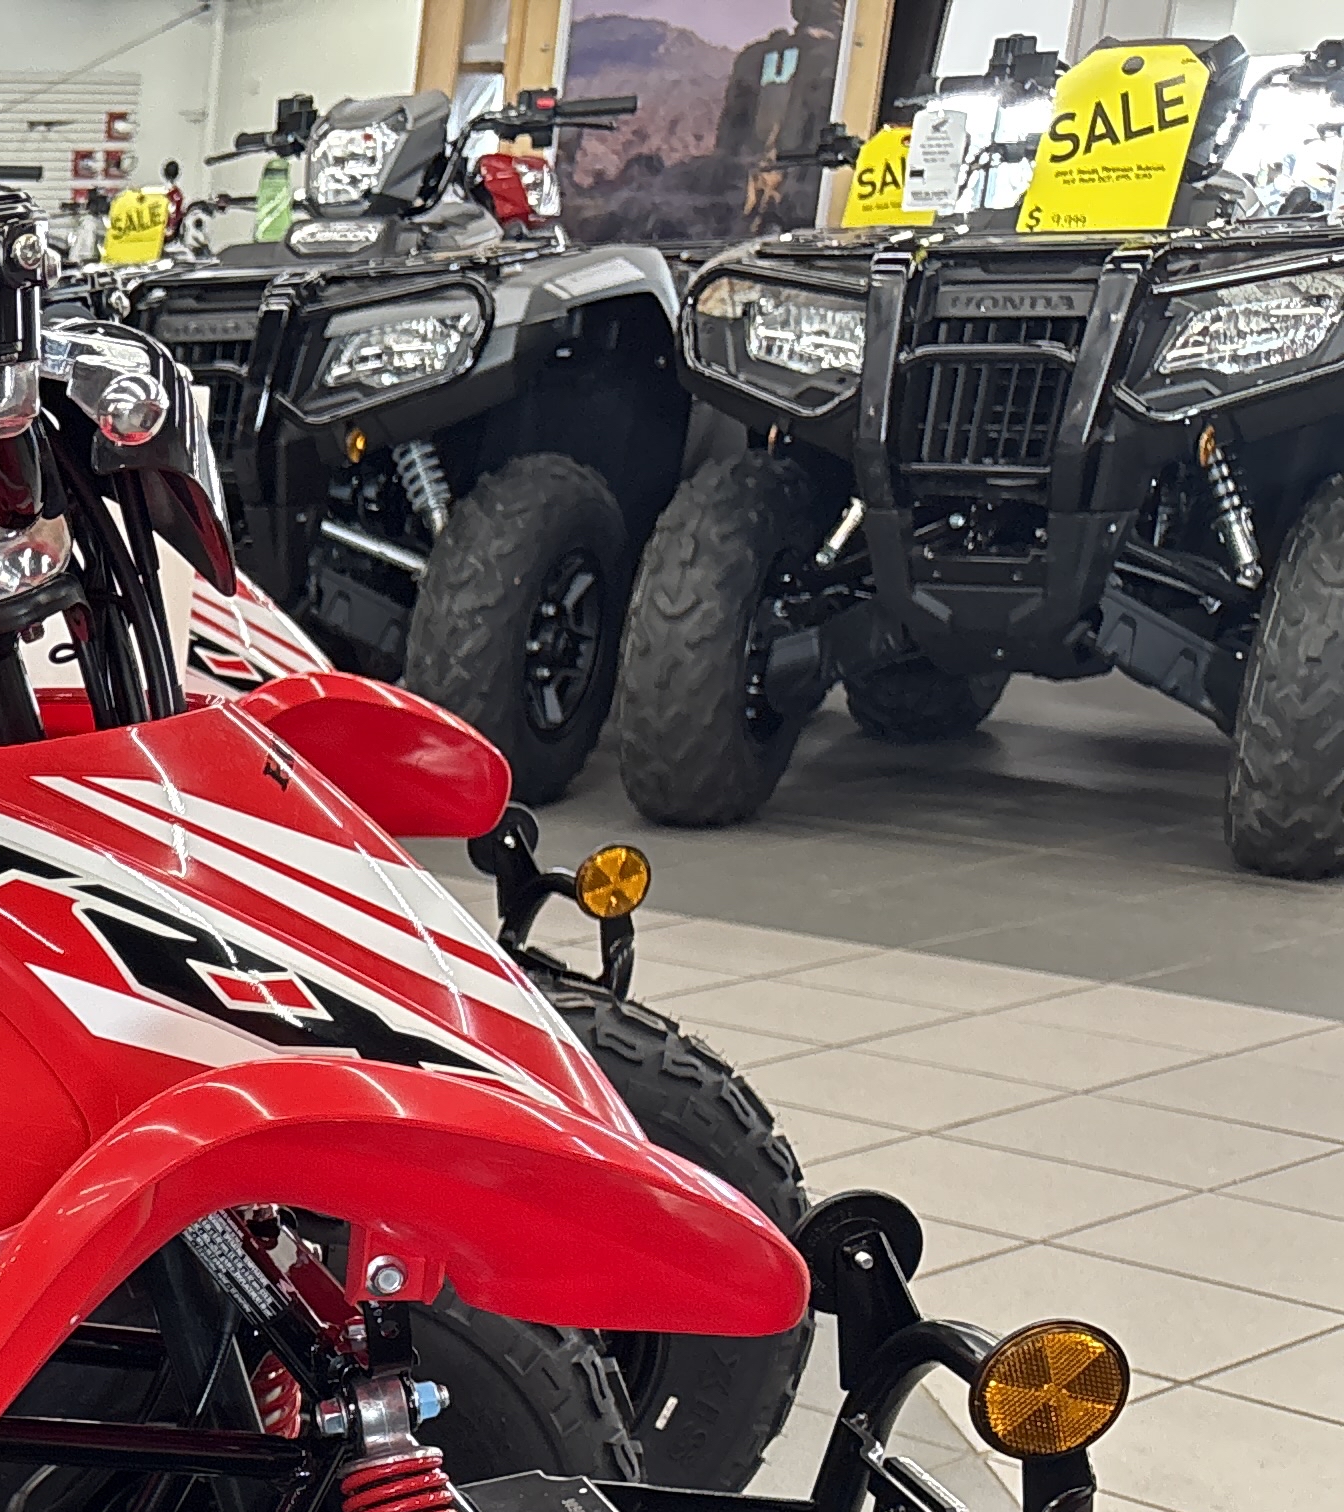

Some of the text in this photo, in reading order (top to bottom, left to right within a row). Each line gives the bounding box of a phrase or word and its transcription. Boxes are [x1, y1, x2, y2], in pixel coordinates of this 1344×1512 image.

[1048, 75, 1189, 163] SALE
[111, 203, 162, 240] SALE
[950, 294, 1076, 311] HONDA
